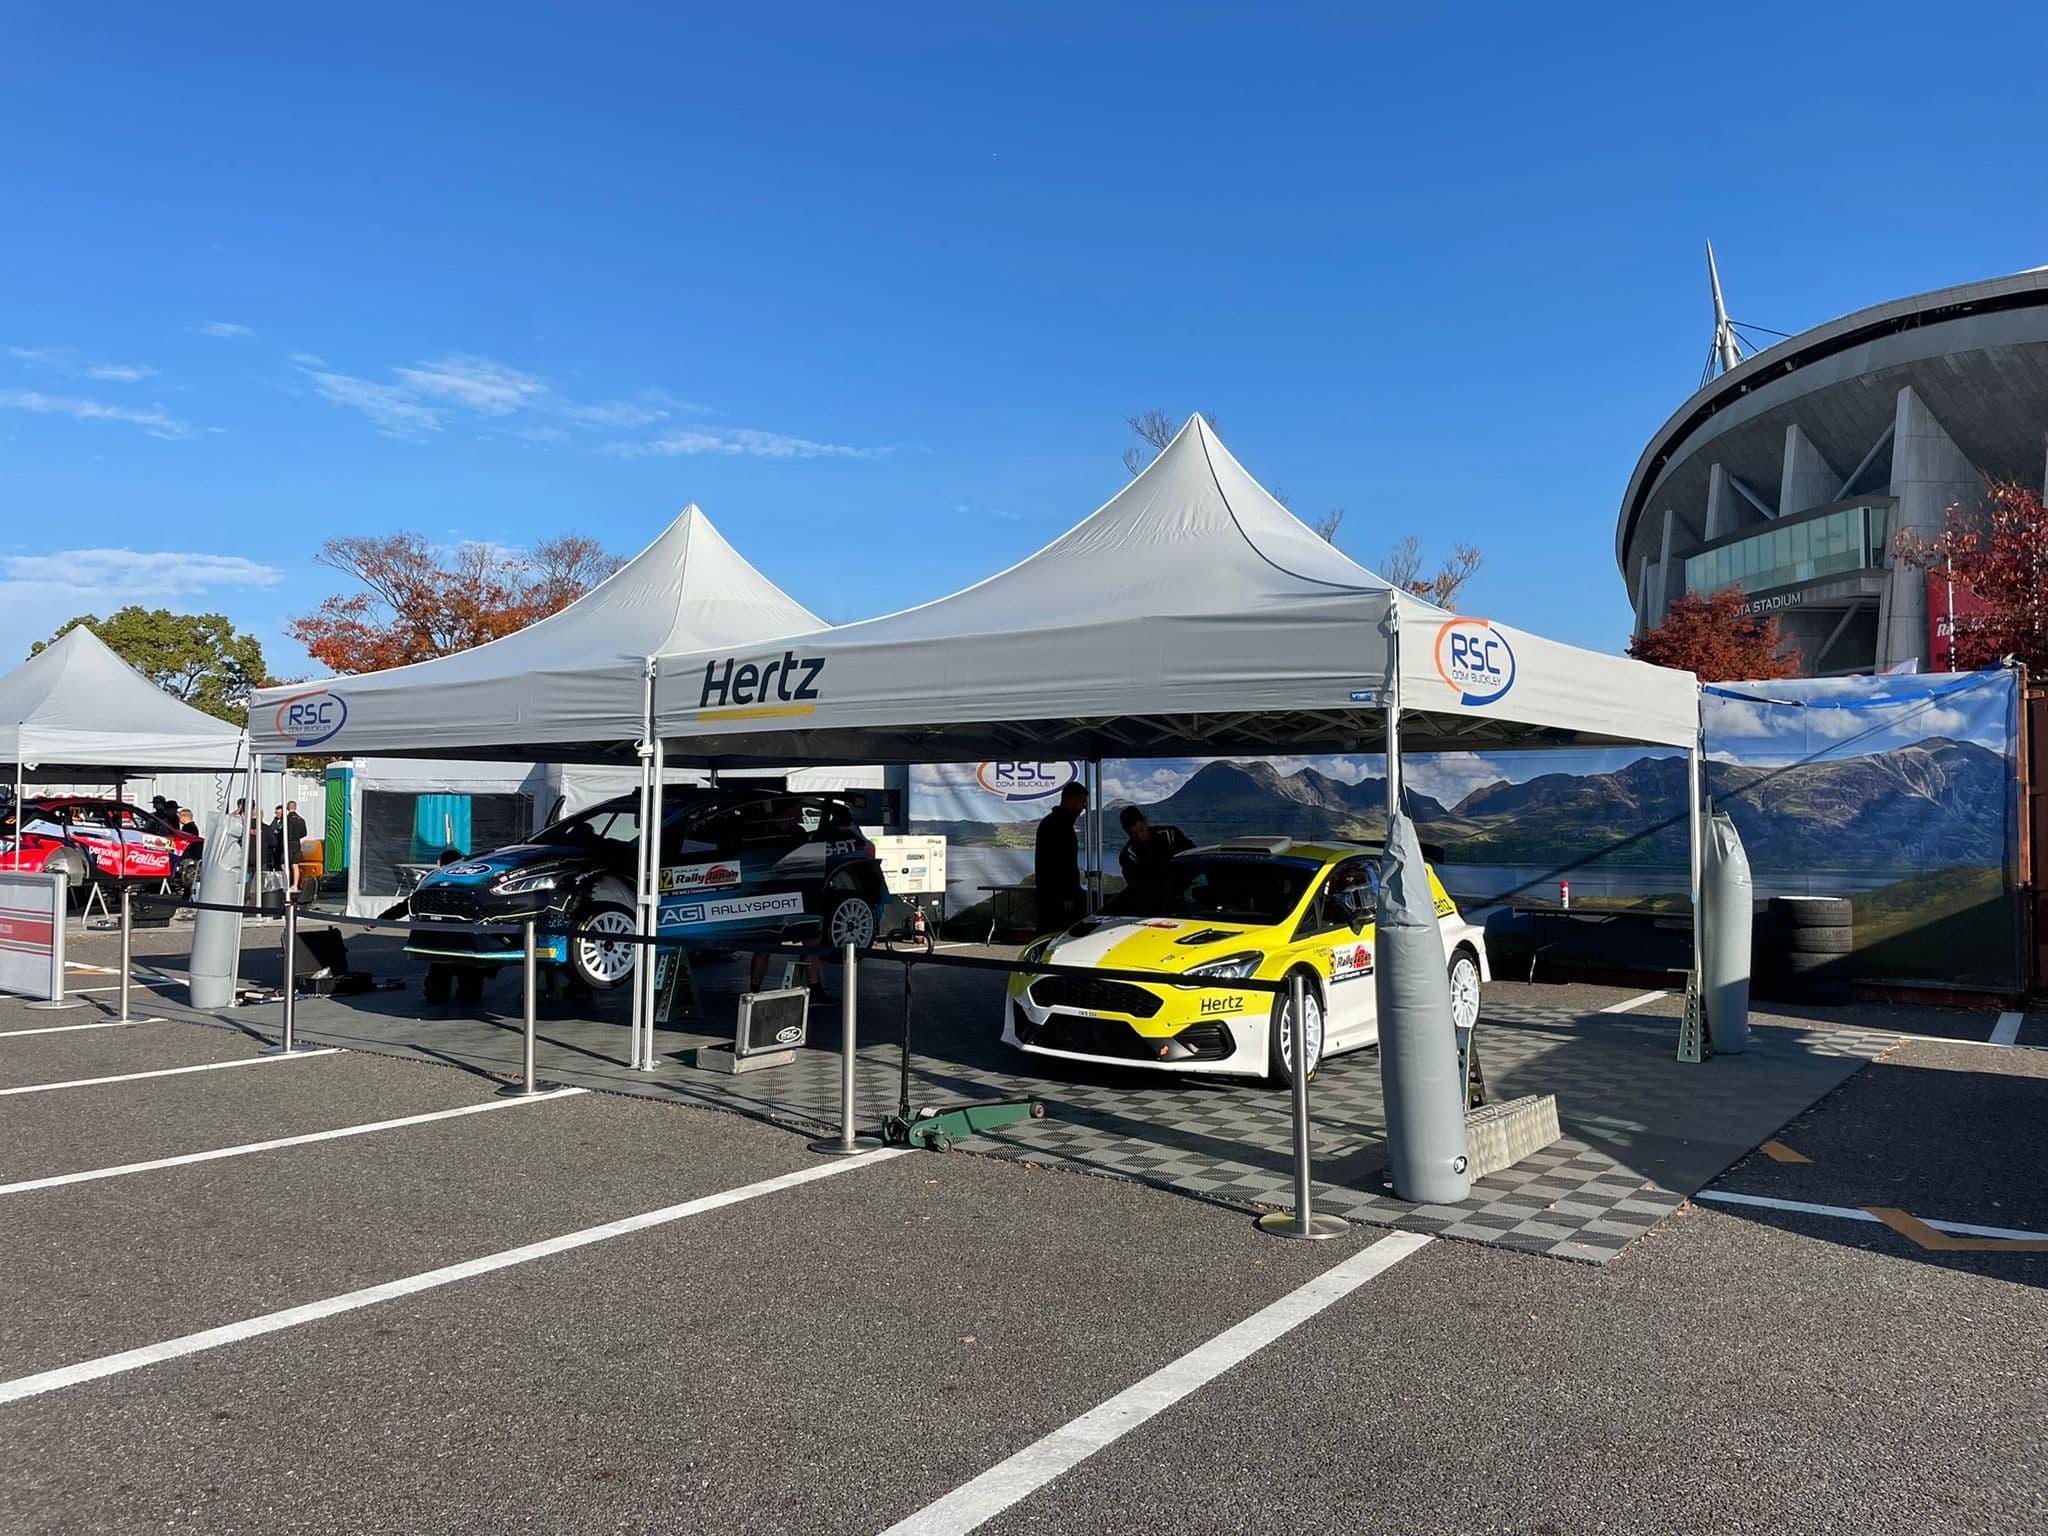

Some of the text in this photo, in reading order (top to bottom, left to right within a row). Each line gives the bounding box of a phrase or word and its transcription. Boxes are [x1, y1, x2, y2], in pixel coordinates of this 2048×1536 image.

[1753, 592, 1801, 613] STADIUM
[1451, 632, 1500, 675] RSC
[700, 651, 826, 708] Hertz
[1452, 669, 1501, 687] DOM BUCKLEY
[288, 702, 333, 726] RSC
[996, 761, 1056, 780] RSC
[127, 851, 169, 867] Rally2
[675, 873, 705, 884] Rally
[707, 870, 738, 881] Japan
[661, 898, 798, 923] AGI RALLYSPORT
[1337, 955, 1353, 968] Rally
[1201, 995, 1243, 1012] Hertz
[781, 1030, 797, 1039] RSC
